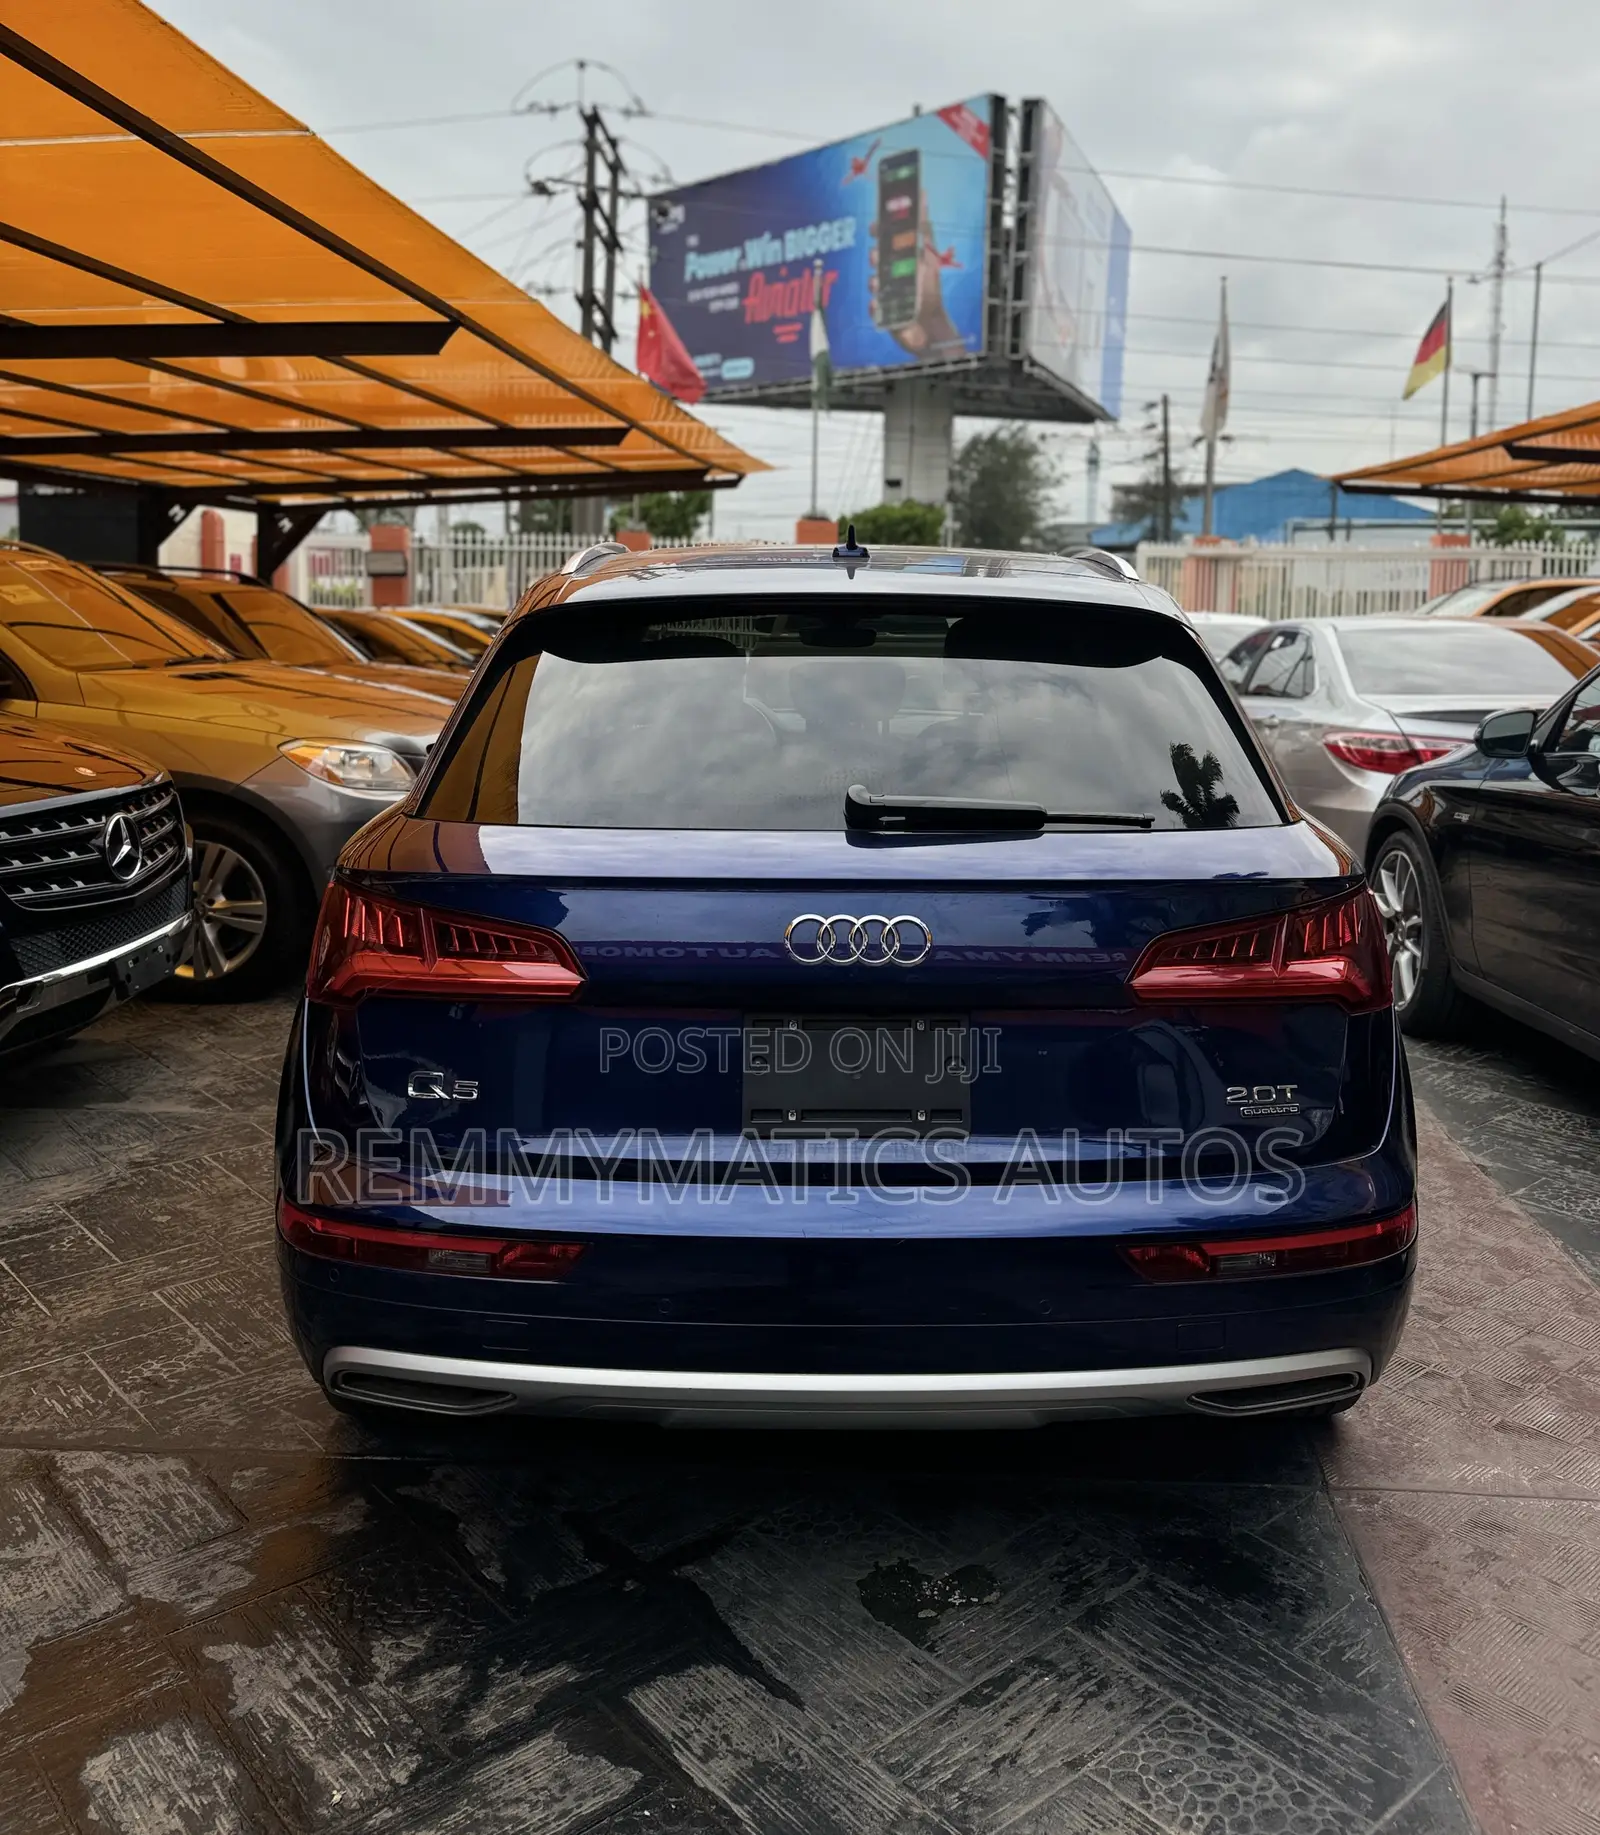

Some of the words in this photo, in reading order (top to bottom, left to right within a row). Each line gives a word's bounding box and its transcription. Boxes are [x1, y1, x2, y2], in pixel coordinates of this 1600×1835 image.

[784, 216, 856, 261] BIGGER
[742, 266, 839, 324] Aviatr
[407, 1070, 478, 1099] Q5
[1226, 1085, 1298, 1104] 2.0T
[1243, 1106, 1298, 1116] quattro
